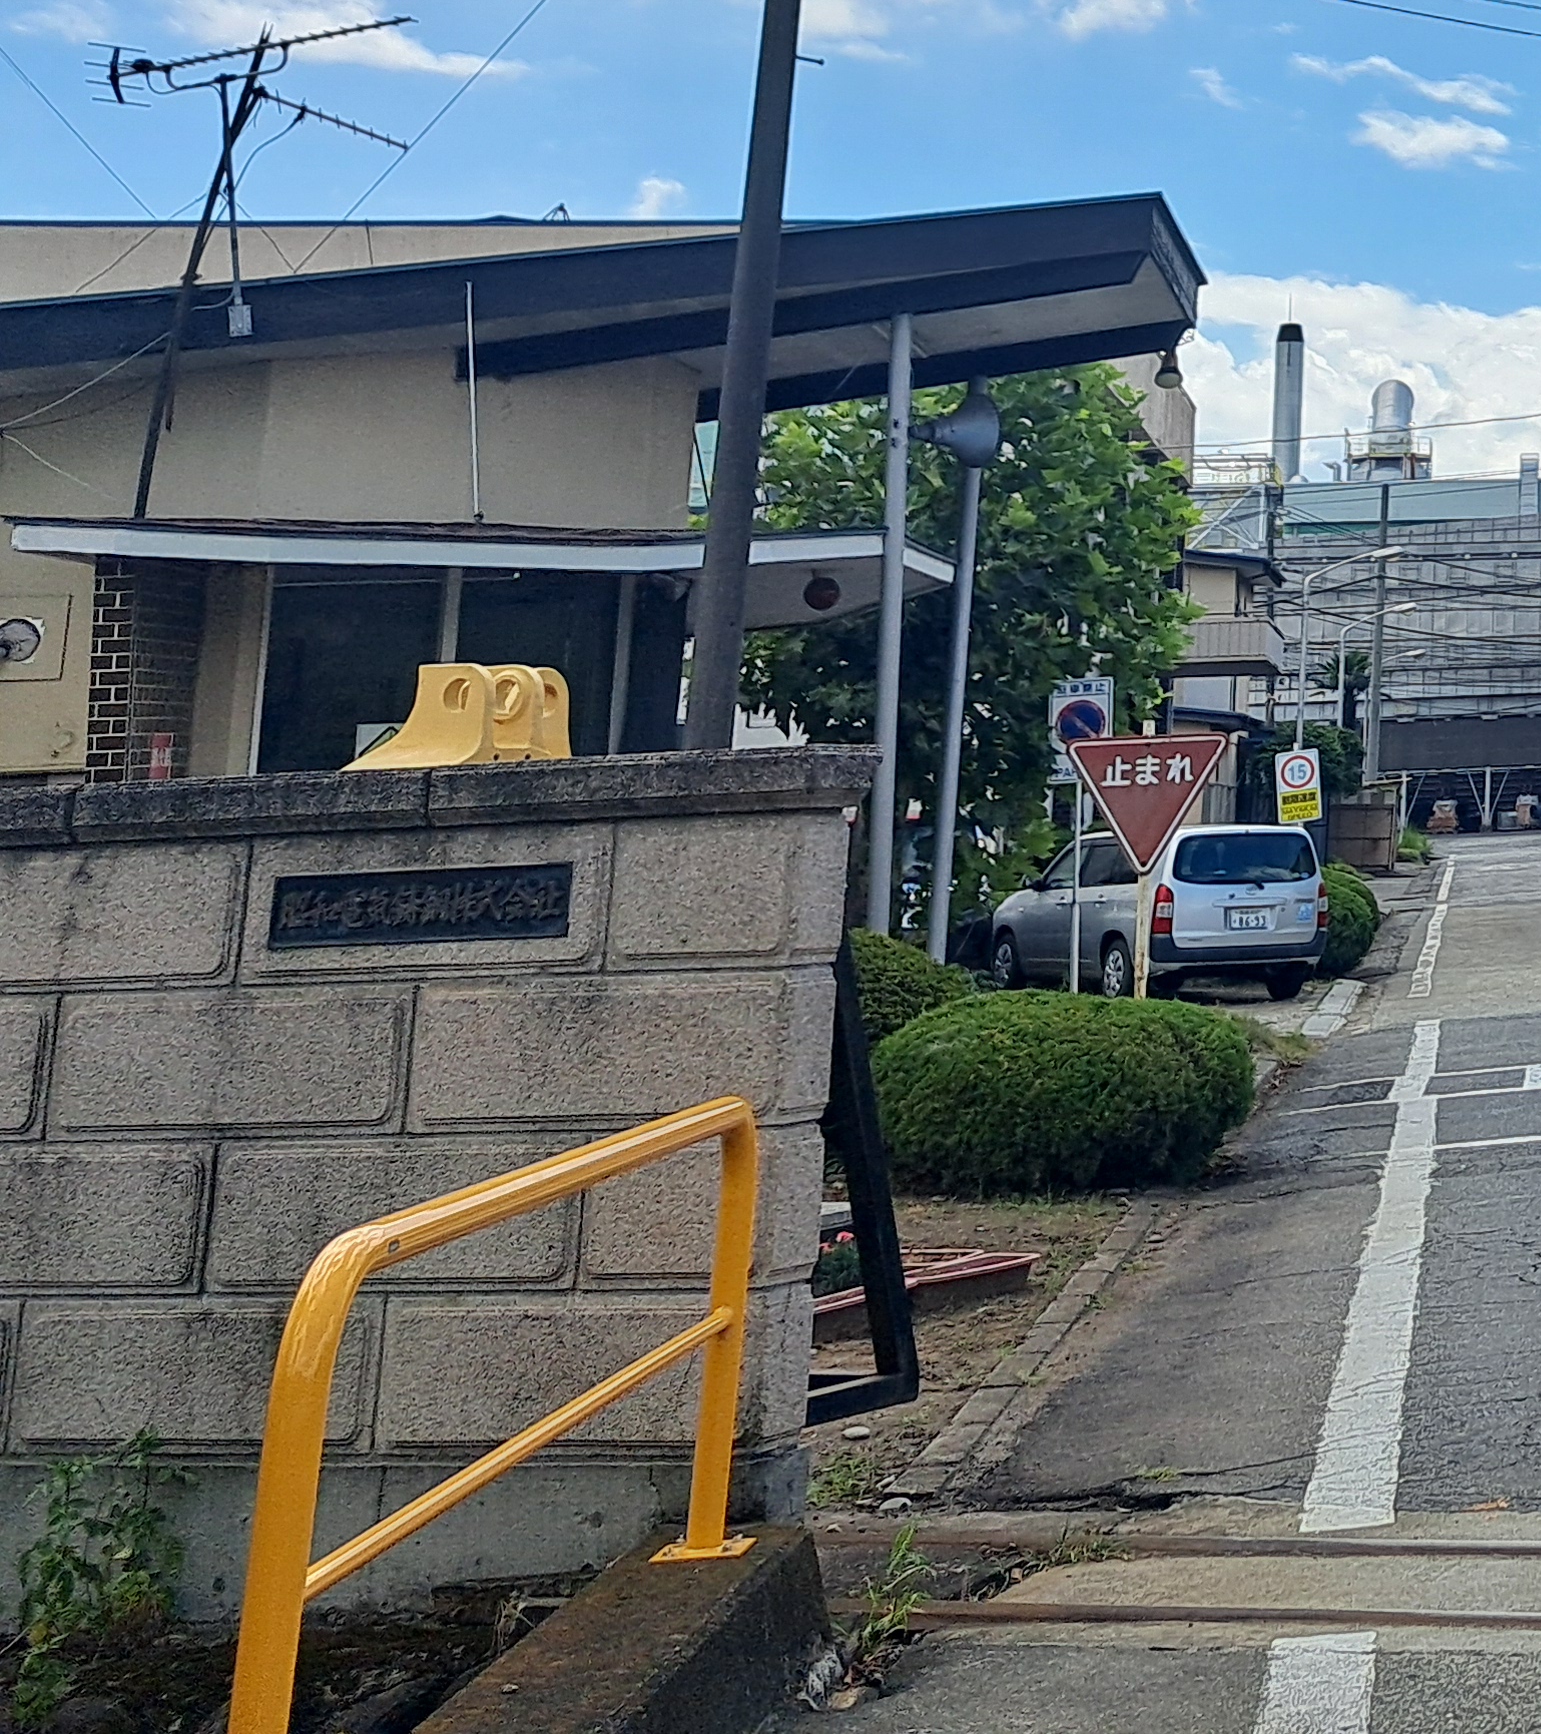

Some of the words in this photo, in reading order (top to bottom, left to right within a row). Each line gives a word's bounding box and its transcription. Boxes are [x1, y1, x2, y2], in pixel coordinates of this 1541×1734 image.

[1100, 752, 1195, 787] 止まれ
[1287, 763, 1308, 782] 15
